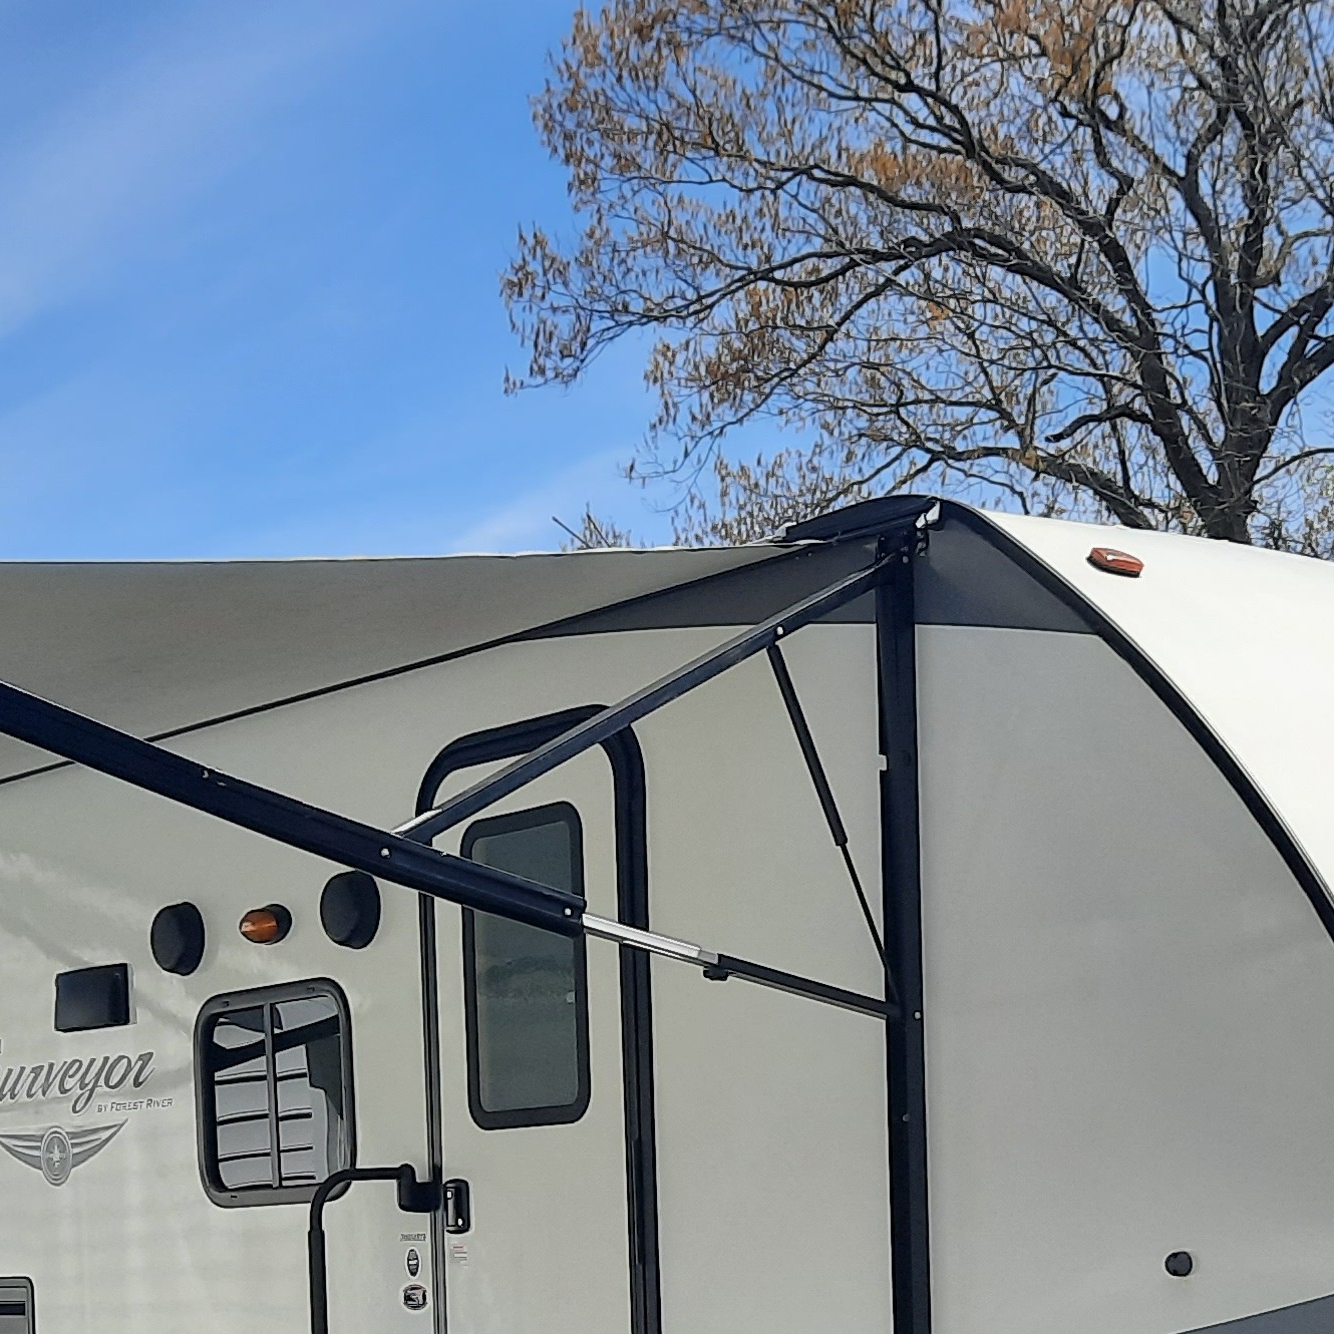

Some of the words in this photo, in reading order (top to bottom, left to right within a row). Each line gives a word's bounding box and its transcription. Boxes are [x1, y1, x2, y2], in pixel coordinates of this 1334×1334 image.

[97, 1104, 108, 1113] BY
[110, 1100, 144, 1112] FOREST
[146, 1097, 173, 1109] RIVER
